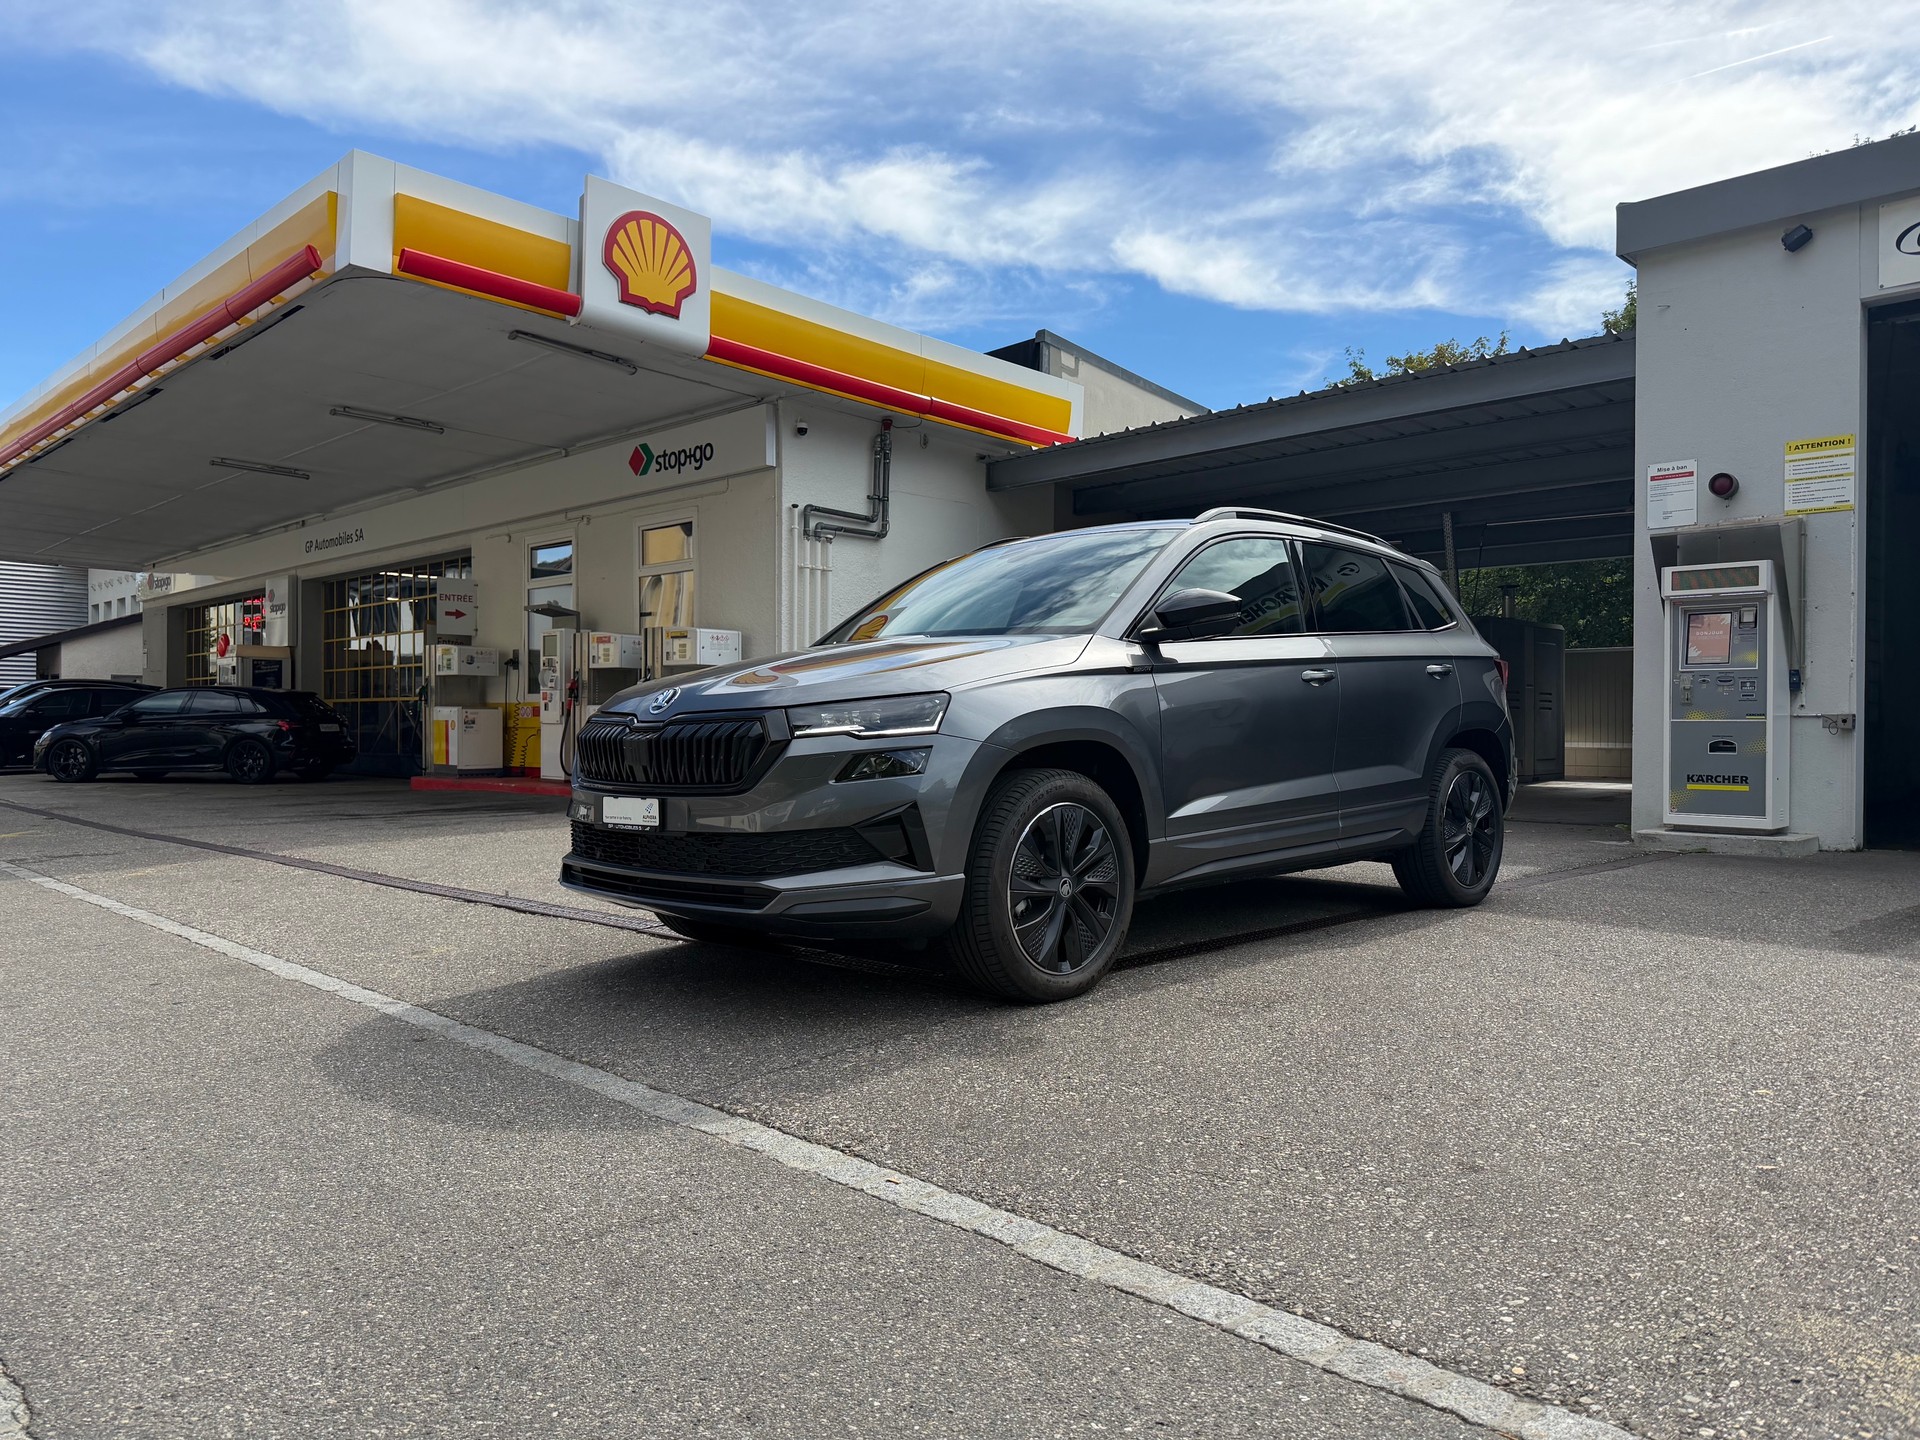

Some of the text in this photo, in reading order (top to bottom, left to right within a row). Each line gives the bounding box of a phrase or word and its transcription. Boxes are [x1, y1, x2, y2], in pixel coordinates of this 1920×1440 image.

[1793, 439, 1845, 451] ATTENTION
[655, 442, 714, 474] stop+go
[305, 528, 365, 553] GP Automobiles SA
[439, 593, 473, 603] ENTRÉE
[1686, 774, 1749, 785] KÄRCHER
